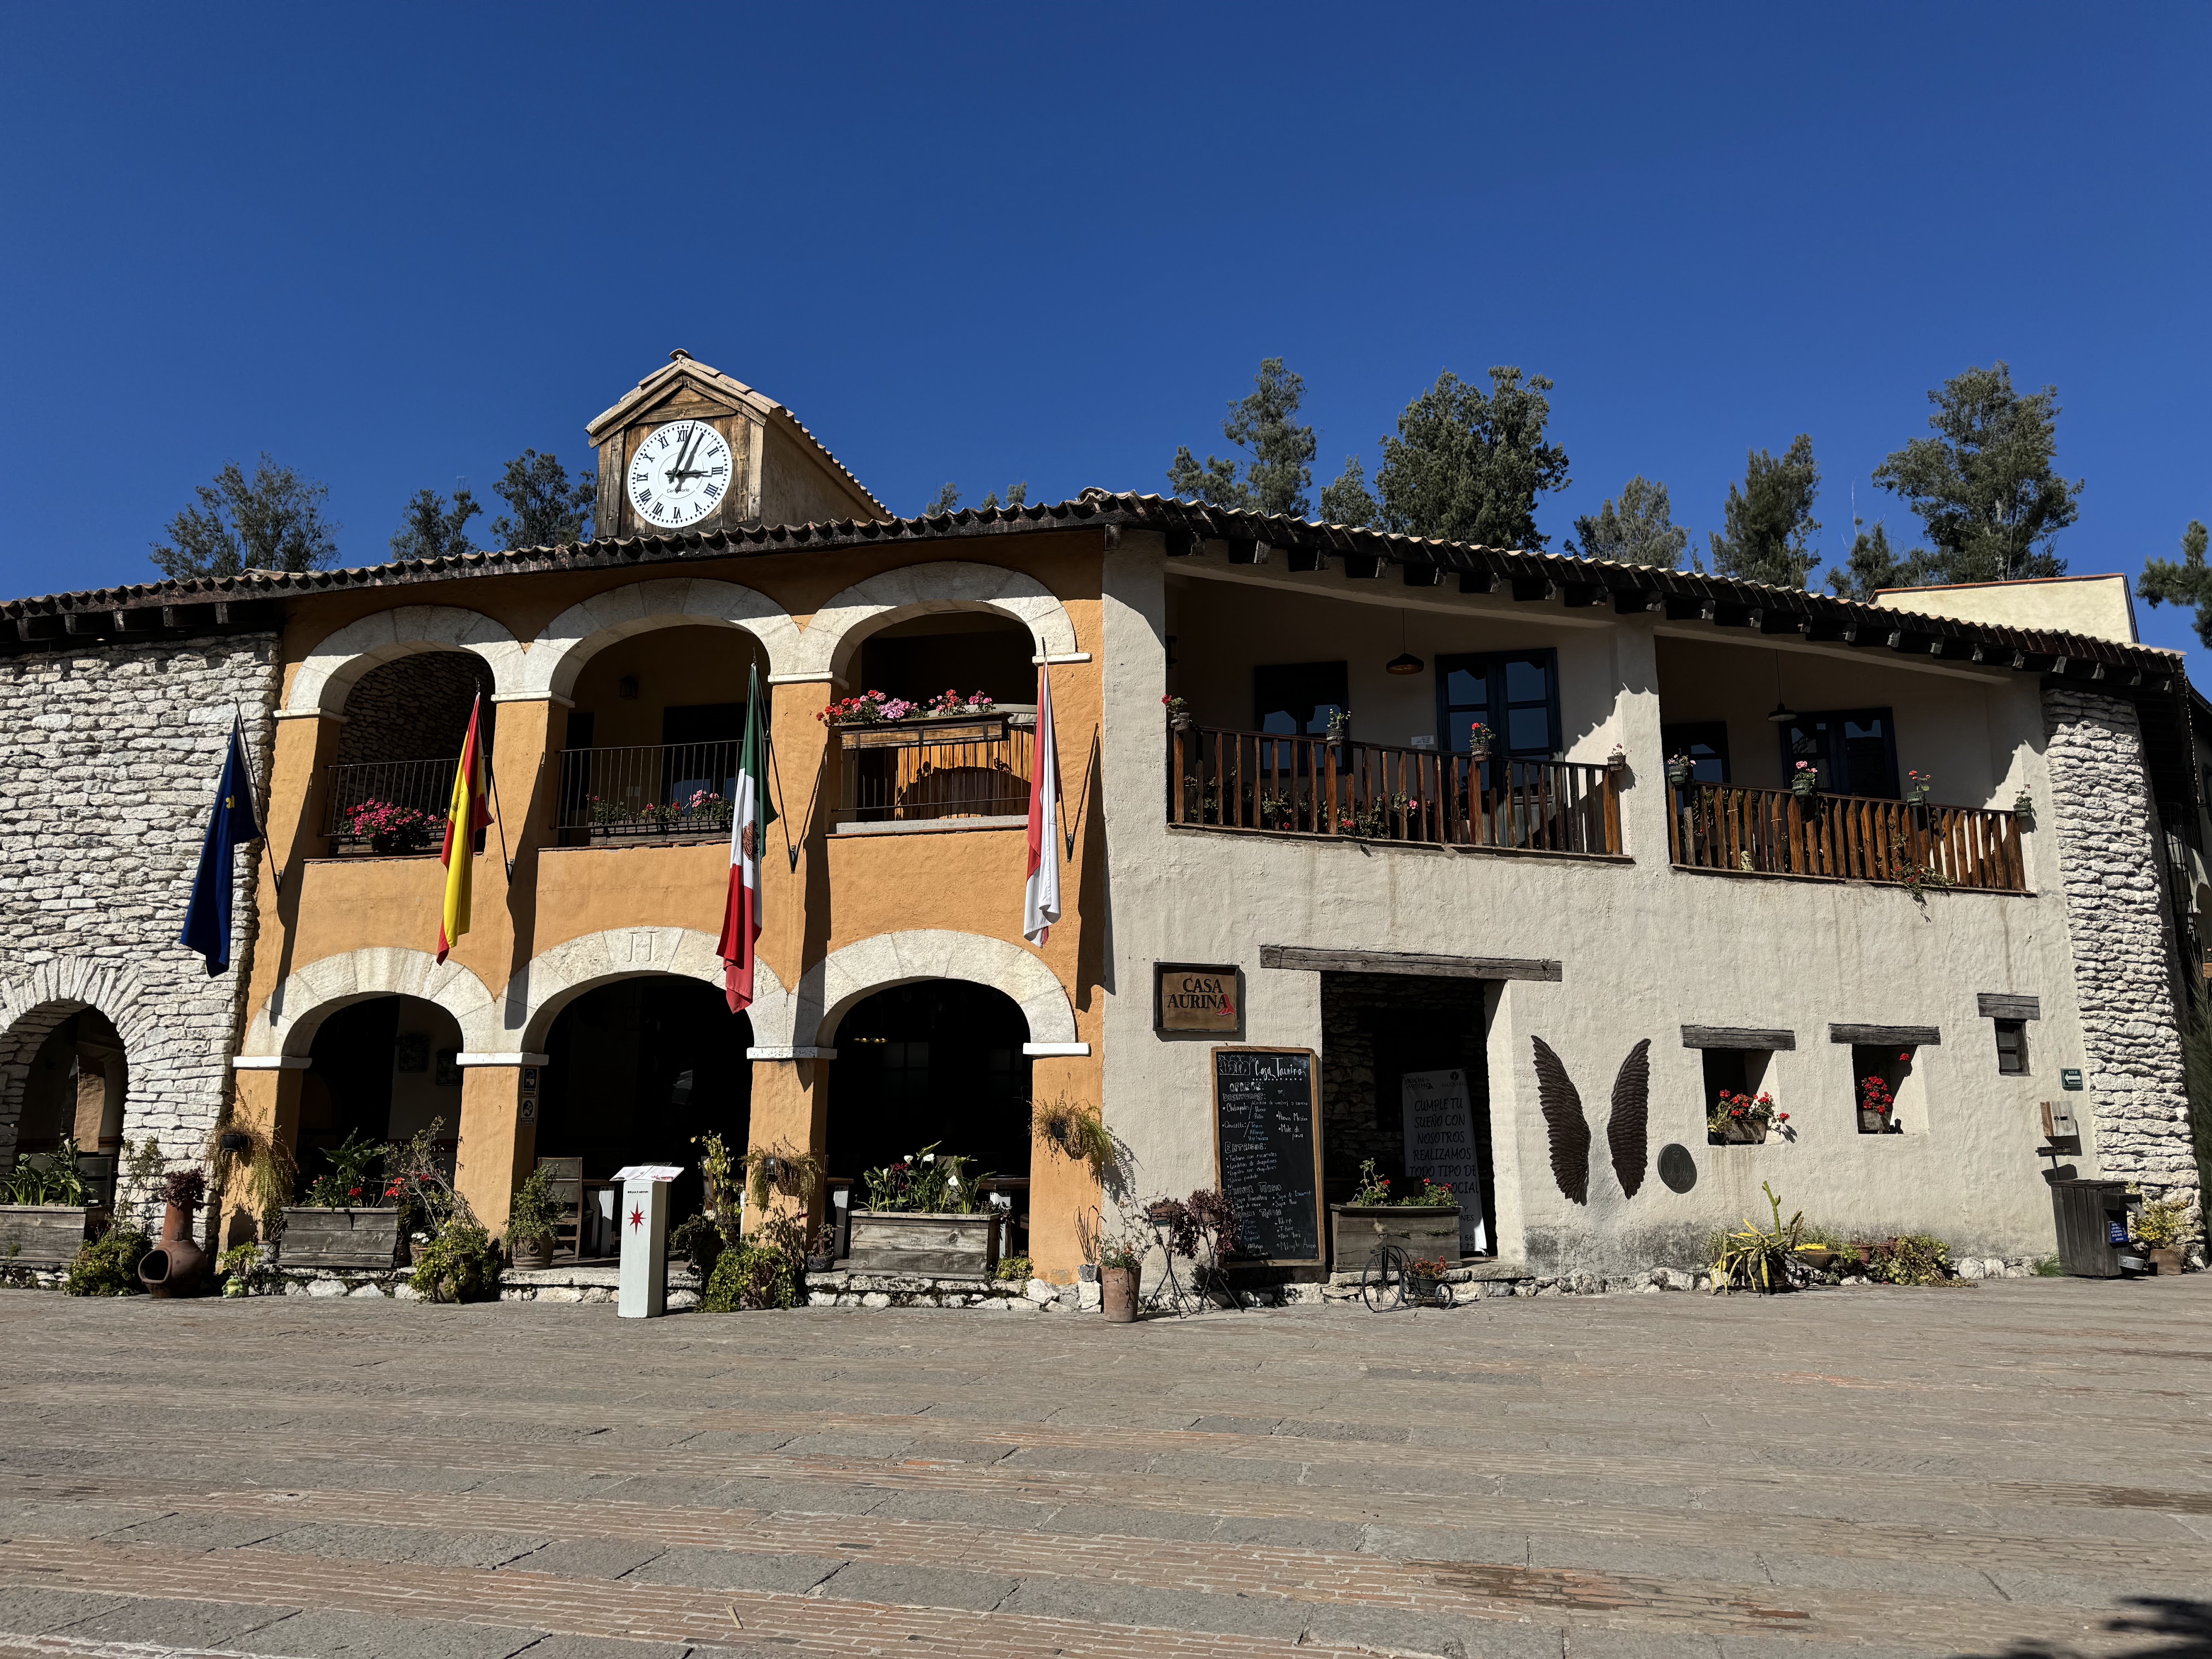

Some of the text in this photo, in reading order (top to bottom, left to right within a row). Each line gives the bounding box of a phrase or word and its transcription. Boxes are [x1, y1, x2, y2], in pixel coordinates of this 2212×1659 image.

[657, 435, 670, 450] XI
[643, 453, 655, 463] X
[707, 446, 719, 458] II
[712, 466, 723, 475] III
[636, 472, 648, 482] IX
[639, 488, 653, 505] VIII
[652, 501, 664, 517] VII
[694, 501, 702, 512] V
[673, 507, 681, 519] VI
[1182, 978, 1224, 993] CASA
[1255, 1060, 1276, 1081] Casa
[1230, 1081, 1264, 1092] OFRECE:
[1223, 1093, 1266, 1101] DESAYUNOS:
[1415, 1098, 1463, 1112] CUMPLE TU
[1414, 1113, 1465, 1129] SUEÑO CON
[1418, 1131, 1465, 1144] NOSOTROS
[1224, 1141, 1266, 1153] ENTRADAS:
[1413, 1147, 1471, 1162] REALIZAMOS
[1409, 1165, 1476, 1177] TODO TIPO DE
[1446, 1181, 1479, 1194] OCIAL
